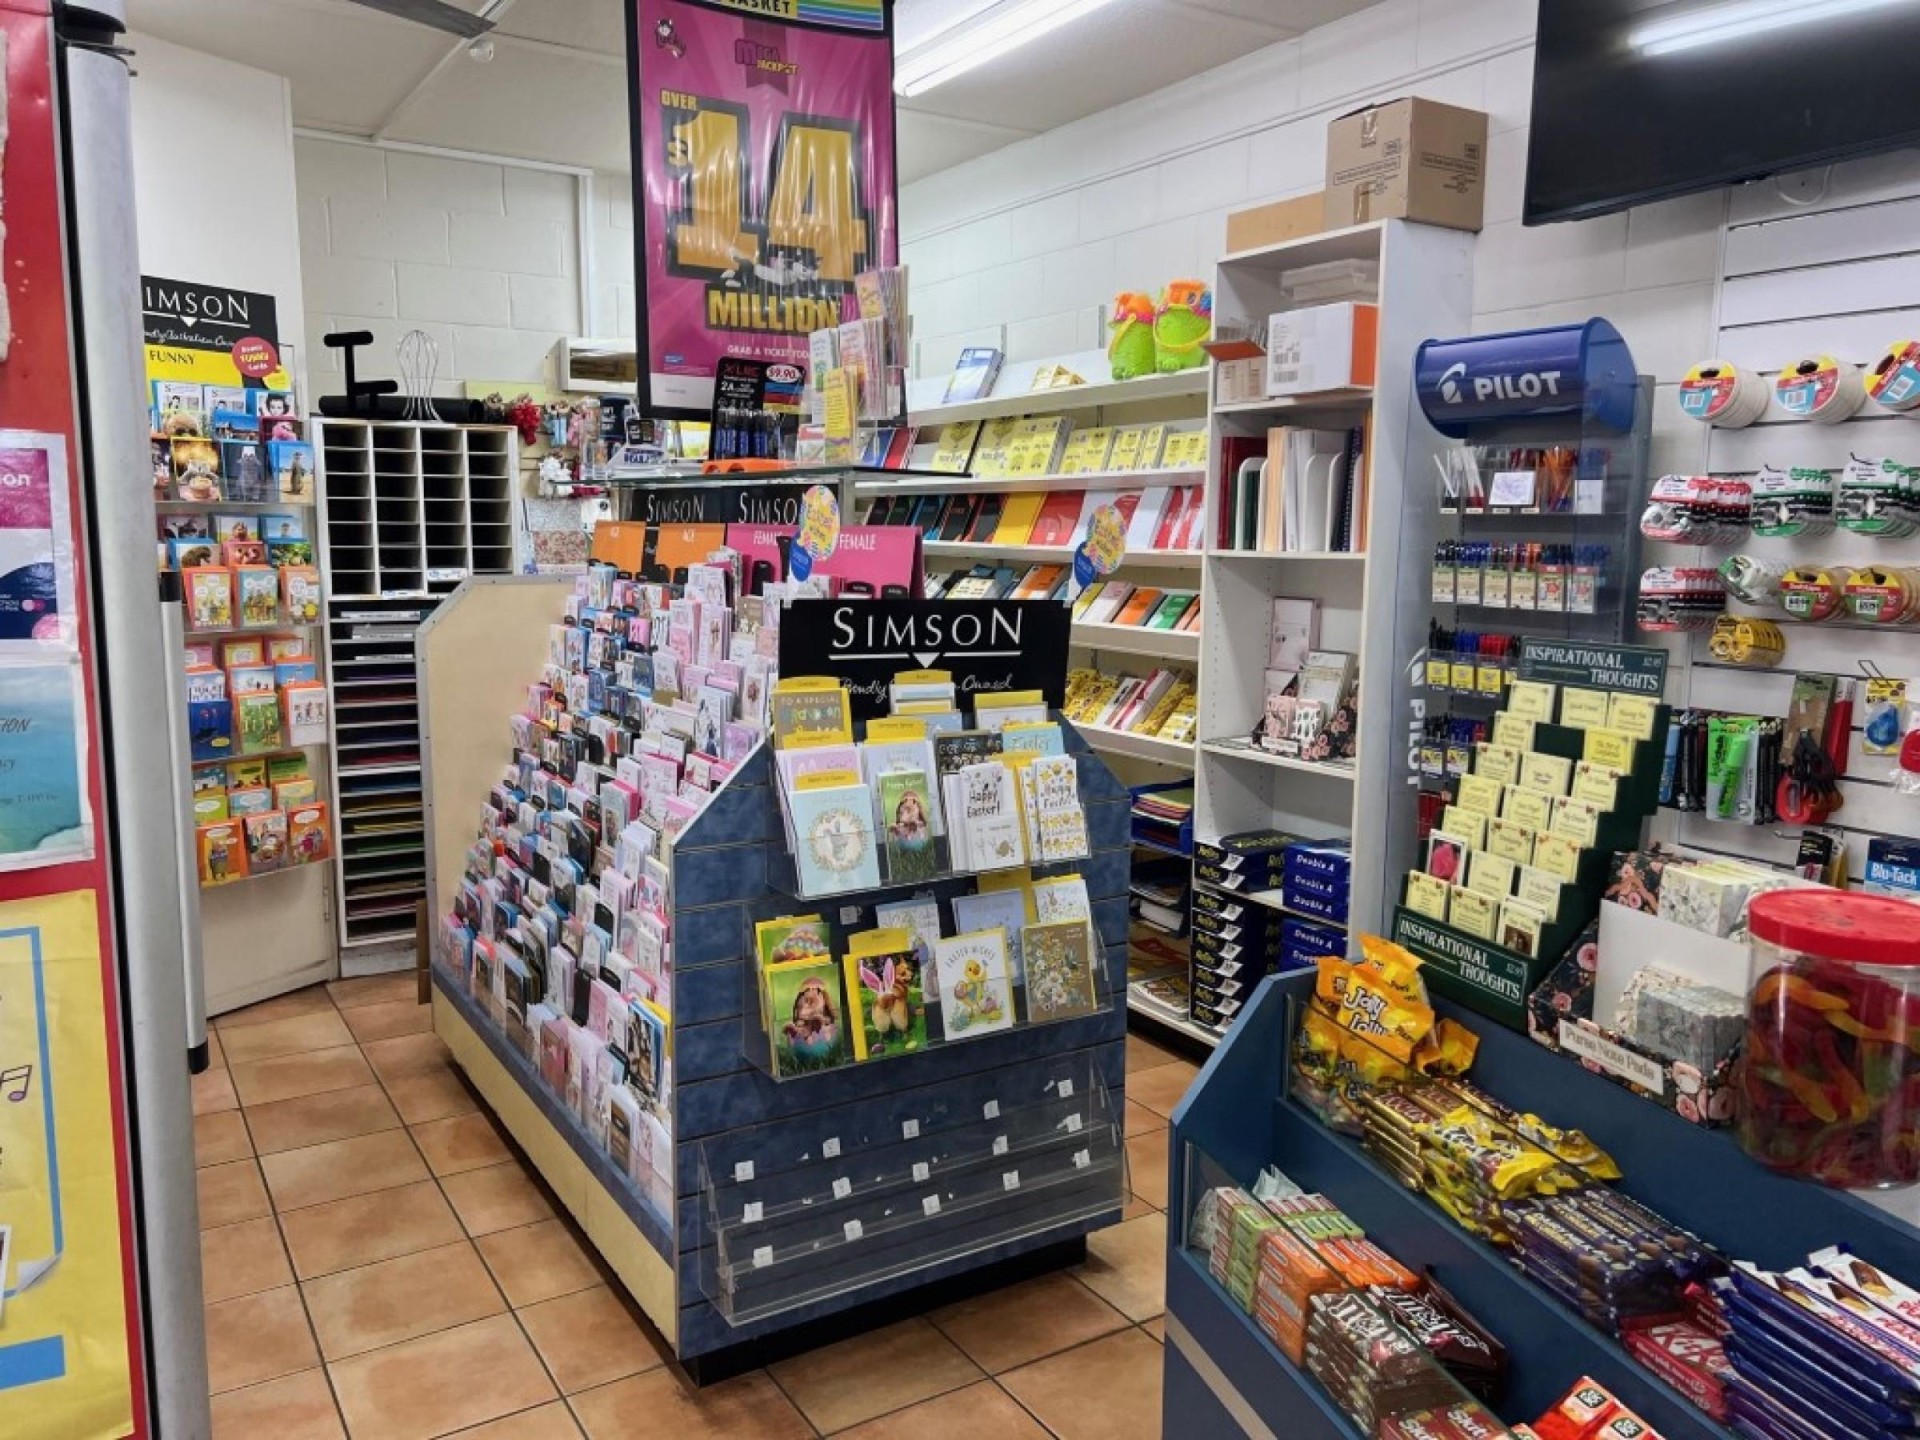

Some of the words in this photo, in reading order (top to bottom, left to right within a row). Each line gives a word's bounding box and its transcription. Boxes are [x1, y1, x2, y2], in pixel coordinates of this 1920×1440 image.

[733, 0, 790, 14] ASKET
[660, 88, 698, 111] OVER
[145, 286, 249, 321] IMSON
[708, 288, 839, 332] MILLION
[150, 350, 195, 365] FUNNY
[727, 344, 753, 356] GRAB
[768, 367, 796, 379] $9.90
[1473, 370, 1562, 401] PILOT
[646, 494, 706, 523] SIMSON
[738, 492, 799, 526] SIMSO
[839, 533, 877, 551] FEMALE
[831, 606, 1023, 649] SIMSON
[1524, 645, 1626, 671] INSPIRATIONAL
[1590, 667, 1660, 692] THOUGHTS
[969, 788, 999, 802] Happy
[966, 804, 1000, 818] Easter!
[1328, 863, 1335, 872] A
[1326, 883, 1333, 893] A
[1325, 904, 1332, 914] A
[1399, 917, 1491, 970] INSPIRATIONAL
[1458, 961, 1522, 999] THOUGHTS
[1344, 987, 1388, 1021] Jolly
